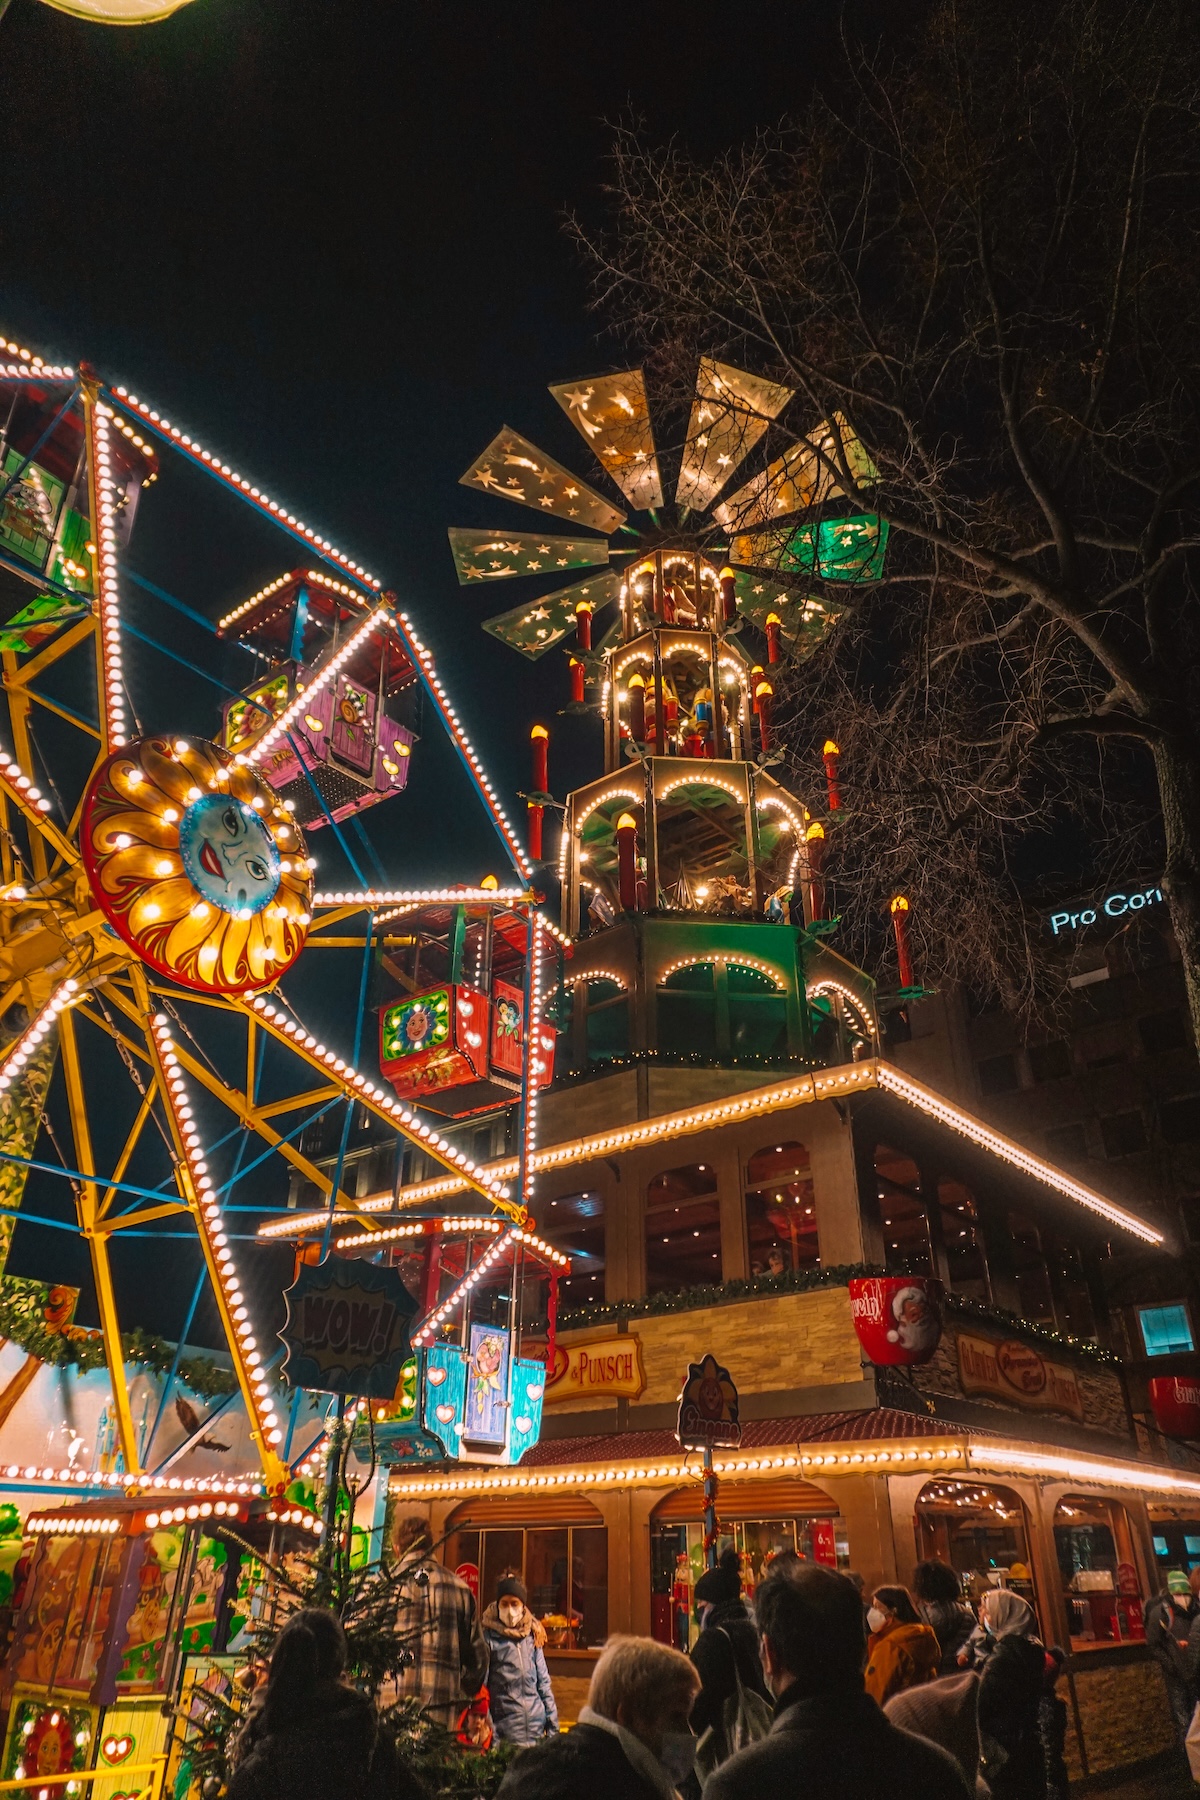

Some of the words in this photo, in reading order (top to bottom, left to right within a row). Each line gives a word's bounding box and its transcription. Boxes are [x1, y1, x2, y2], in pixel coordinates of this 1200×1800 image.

[1051, 909, 1096, 935] Pro
[302, 1295, 396, 1356] WOW!
[571, 1365, 579, 1379] &
[580, 1352, 633, 1385] PUNSCH
[682, 1405, 741, 1446] Eingang
